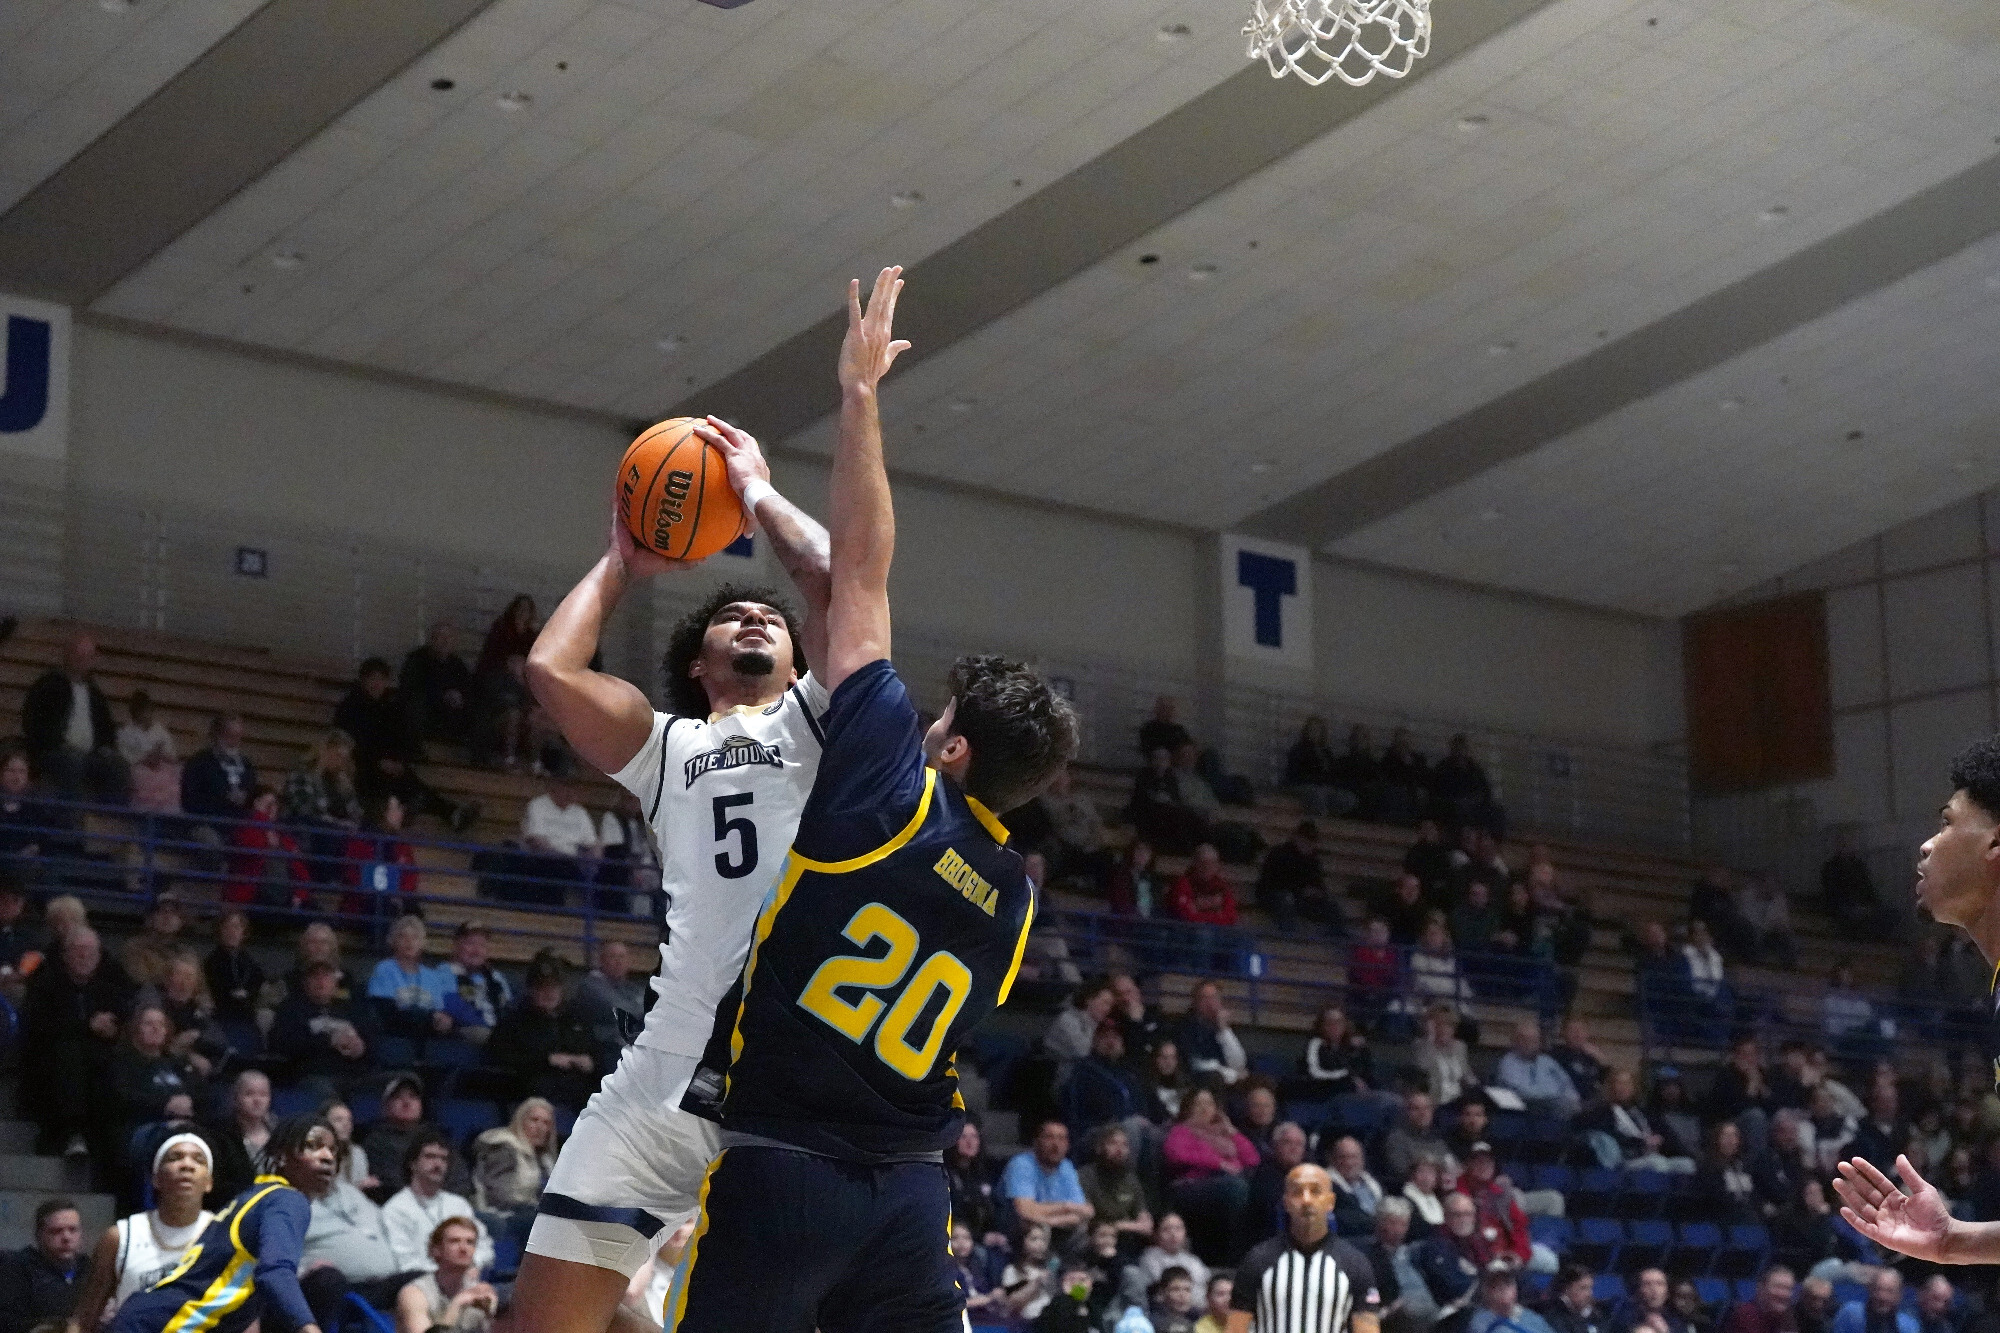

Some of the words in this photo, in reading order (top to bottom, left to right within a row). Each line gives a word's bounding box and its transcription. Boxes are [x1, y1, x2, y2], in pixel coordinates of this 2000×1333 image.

[654, 469, 694, 551] Wilson
[1238, 550, 1296, 648] T
[684, 753, 721, 791] THE
[722, 743, 784, 769] MOUNT
[712, 791, 759, 880] 5
[795, 901, 973, 1082] 20
